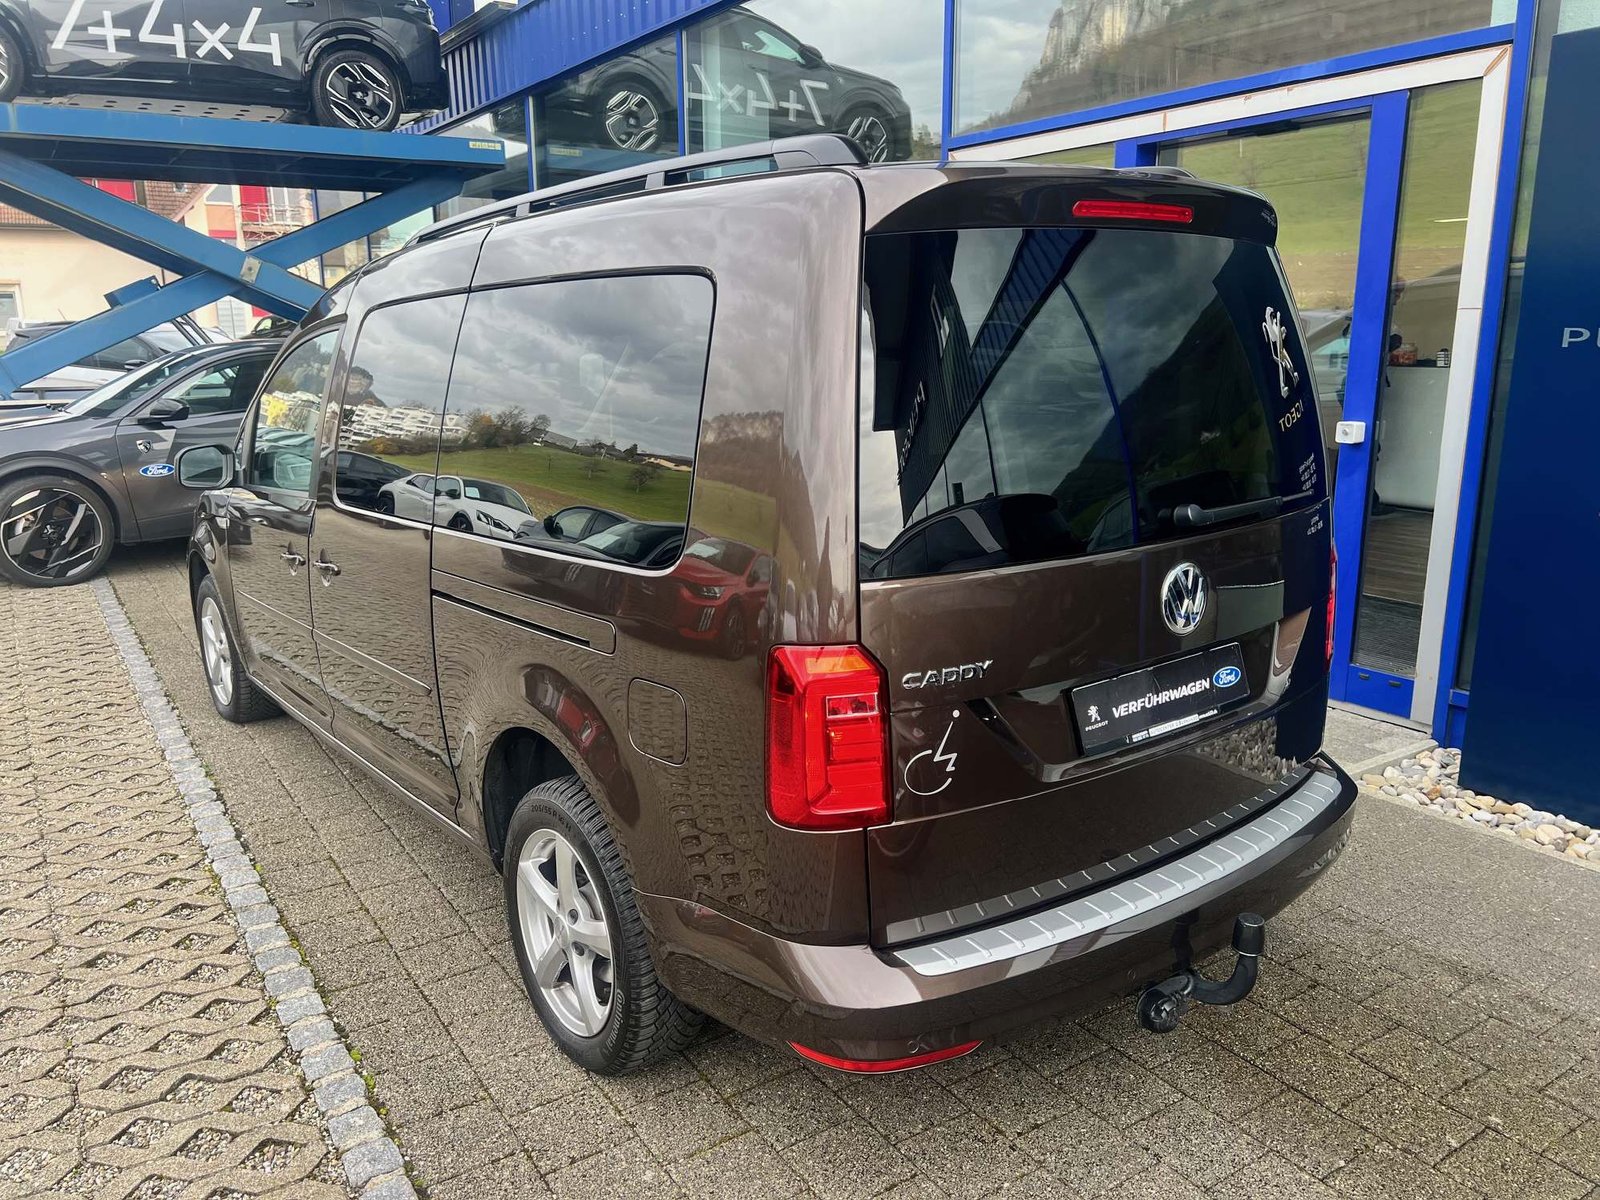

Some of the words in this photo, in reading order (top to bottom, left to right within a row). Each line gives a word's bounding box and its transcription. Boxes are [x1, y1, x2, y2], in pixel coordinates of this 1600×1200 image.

[1561, 327, 1600, 348] P
[902, 659, 994, 690] CADDY
[1112, 677, 1211, 719] VERFÜHRWAGEN
